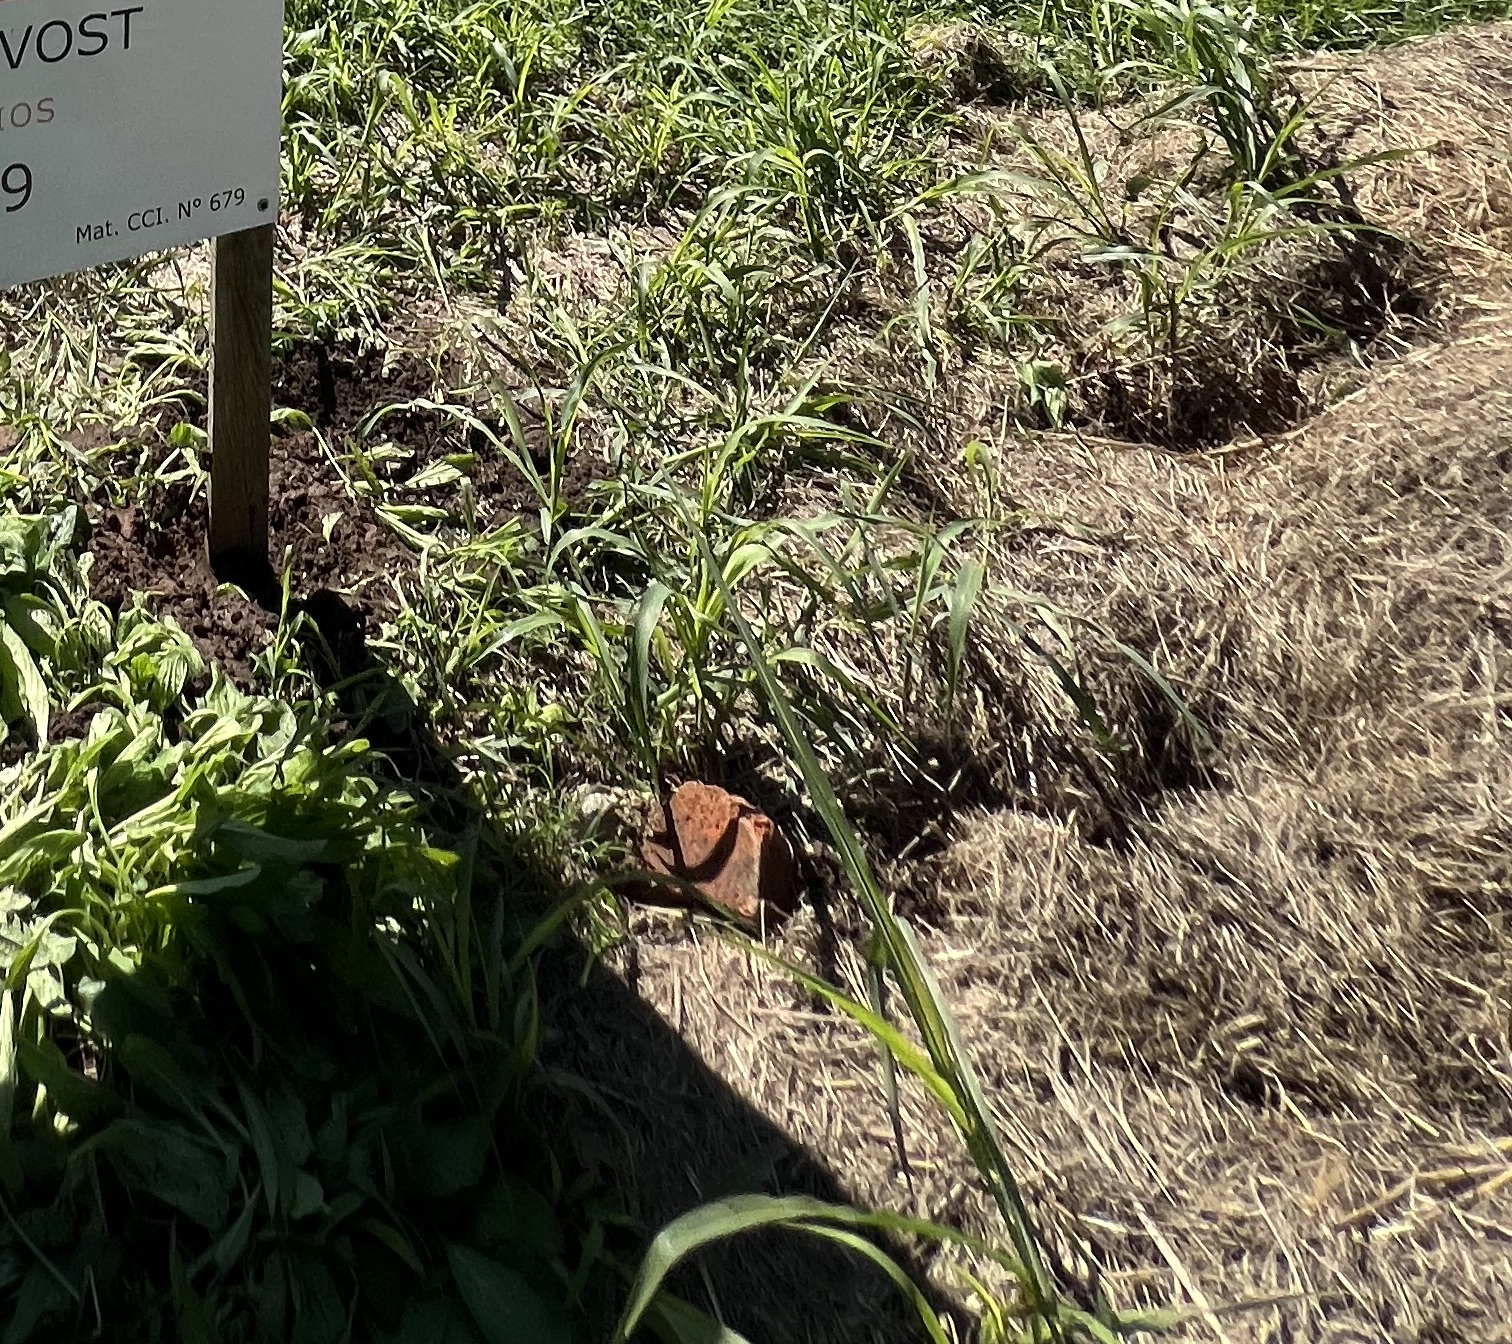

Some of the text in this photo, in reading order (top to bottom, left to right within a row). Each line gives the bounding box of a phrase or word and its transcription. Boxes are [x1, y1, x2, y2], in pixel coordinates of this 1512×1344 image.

[76, 220, 119, 244] Mat.
[127, 207, 169, 231] CCI.
[209, 187, 245, 211] 679
